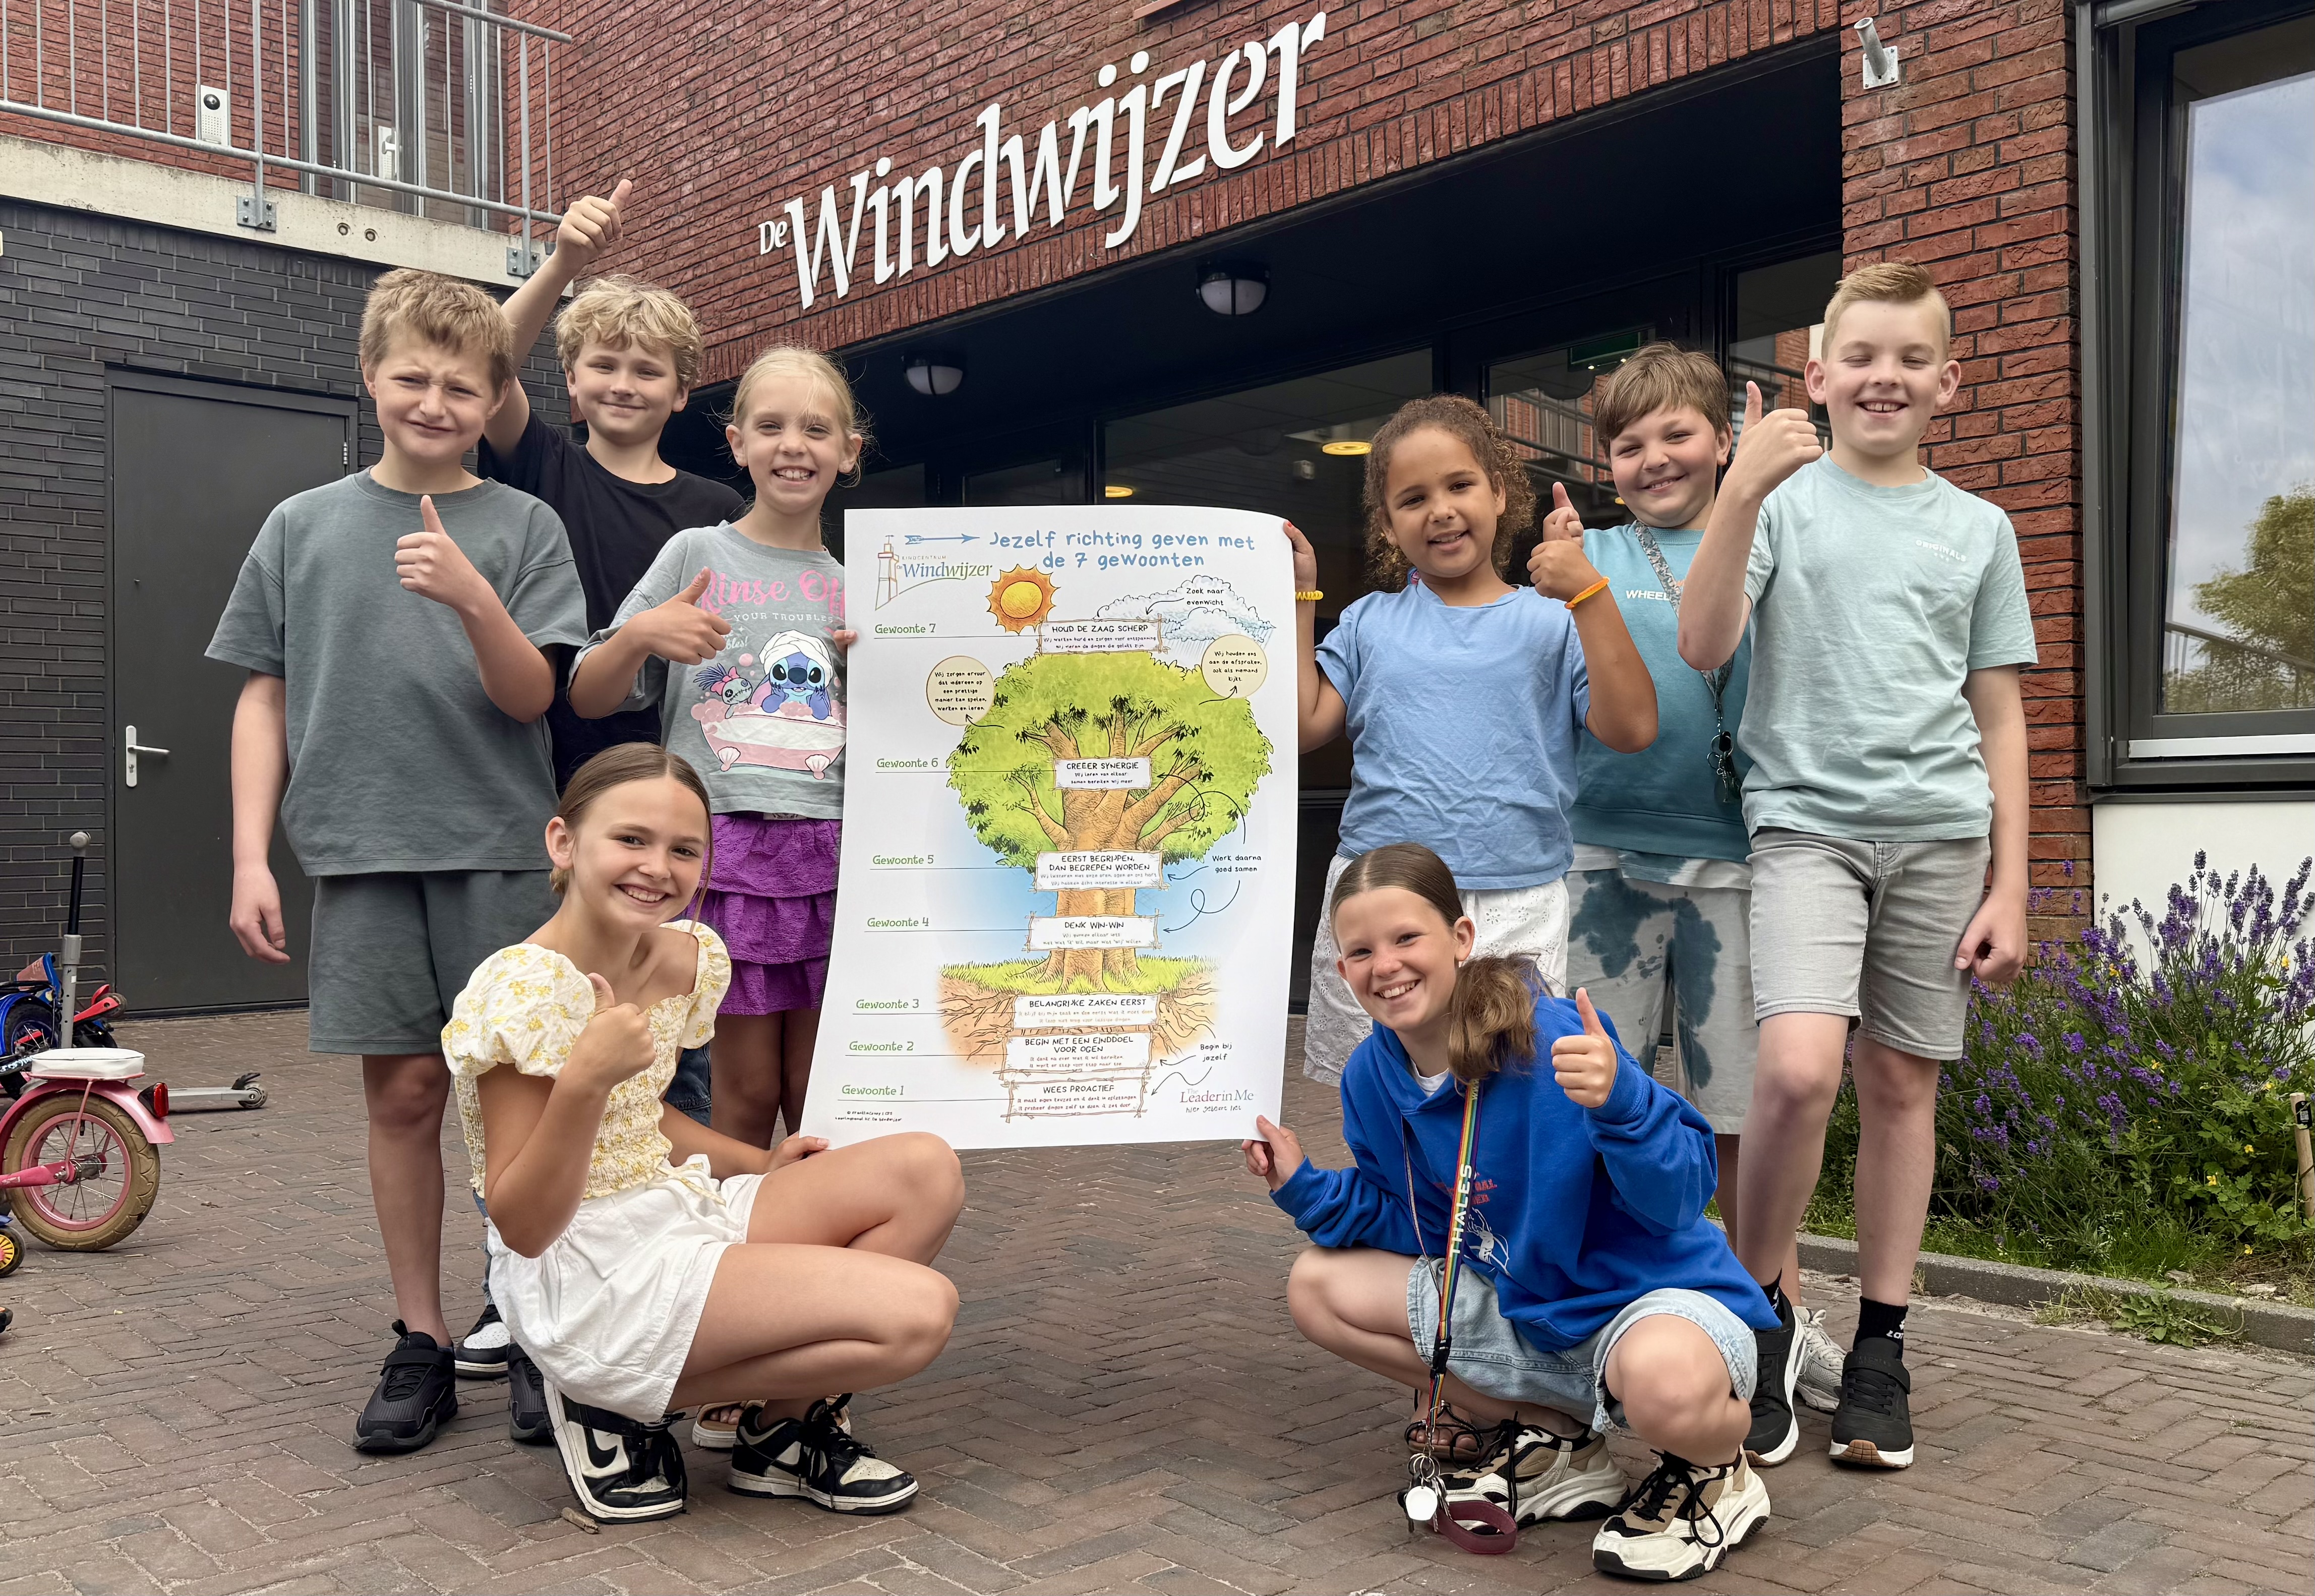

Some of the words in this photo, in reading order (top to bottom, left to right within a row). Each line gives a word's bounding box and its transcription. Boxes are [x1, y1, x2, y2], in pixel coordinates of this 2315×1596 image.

[759, 219, 787, 255] De
[785, 11, 1326, 309] Windwijzer
[989, 530, 1056, 549] Jezelf
[1066, 529, 1142, 550] richting
[1152, 534, 1208, 550] geven
[1218, 535, 1255, 550] met
[1916, 539, 1967, 562] ORIGINALS
[1042, 551, 1065, 568] de
[1075, 552, 1088, 568] 7
[903, 561, 993, 580] Windwijzer
[734, 612, 767, 622] YOUR
[773, 612, 834, 623] TROUBLES
[875, 623, 926, 634] Gewoonte
[929, 623, 936, 633] 7
[876, 758, 928, 769] Gewoonte
[931, 757, 939, 767] 6
[1101, 761, 1139, 770] SYNERGIE
[872, 855, 924, 865] Gewoonte
[927, 855, 934, 864] 5
[867, 917, 919, 927] Gewoonte
[922, 917, 929, 926] 4
[1090, 921, 1124, 929] WIN-WIN
[856, 999, 909, 1009] Gewoonte
[912, 998, 919, 1009] 3
[1029, 999, 1085, 1008] BELANGRIJKE
[1088, 998, 1117, 1007] ZAKEN
[849, 1041, 903, 1051] Gewoonte
[906, 1041, 914, 1051] 2
[1025, 1038, 1049, 1046] BEGIN
[1092, 1035, 1134, 1044] EINDDOEL
[1222, 1042, 1232, 1050] bij
[1080, 1045, 1103, 1053] OGEN
[842, 1084, 897, 1096] Gewoonte
[900, 1085, 904, 1096] 1
[1070, 1084, 1115, 1092] PROACTIEF
[1179, 1090, 1222, 1103] Leader
[1221, 1090, 1232, 1101] in
[1234, 1089, 1254, 1101] Me
[1450, 1163, 1472, 1255] THALES
